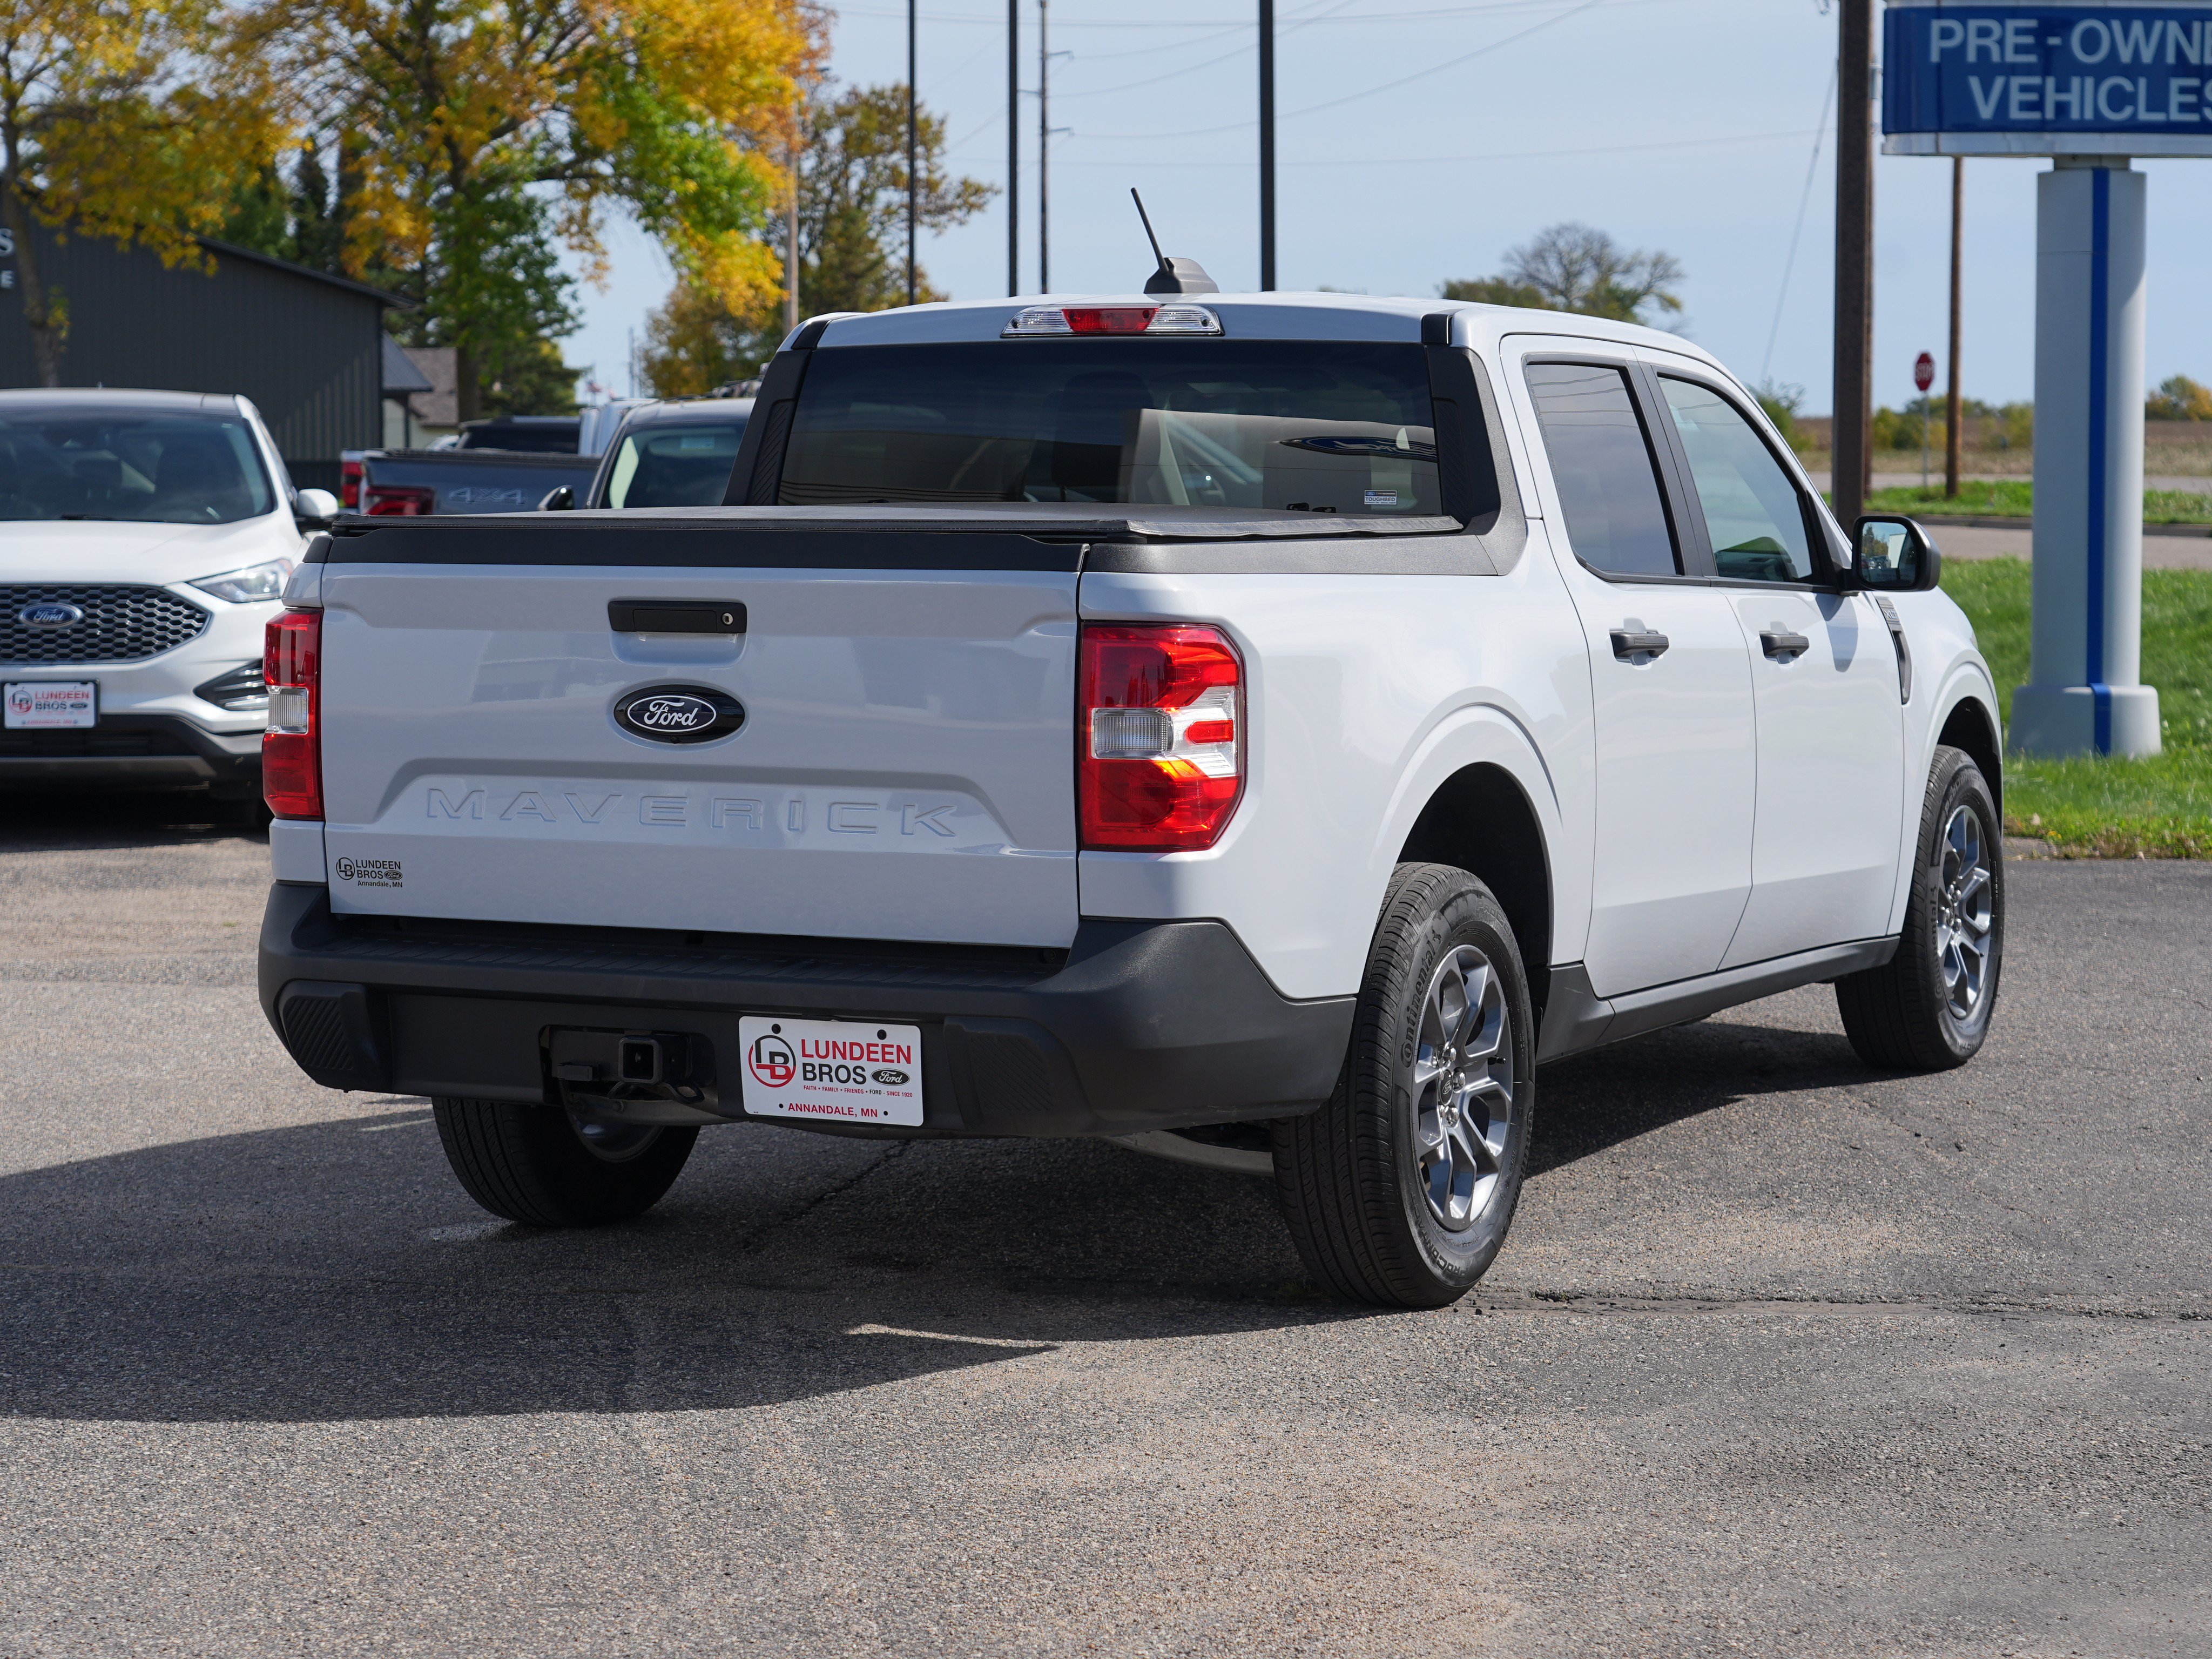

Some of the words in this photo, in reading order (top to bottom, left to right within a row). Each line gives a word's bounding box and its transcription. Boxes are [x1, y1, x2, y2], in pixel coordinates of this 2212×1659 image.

[1930, 18, 2212, 64] PRE-OWN
[1967, 76, 2212, 122] VEHICLE
[33, 609, 64, 622] Ford
[35, 691, 89, 699] LUNDEEN
[35, 701, 67, 710] BROS
[644, 700, 699, 726] Ford
[427, 788, 957, 837] MAVERICK
[355, 859, 401, 869] LUNDEEN
[357, 869, 383, 879] BROS
[358, 880, 392, 888] Annandale,
[1401, 940, 1436, 1068] Continental
[801, 1038, 911, 1064] LUNDEEN
[802, 1062, 867, 1085] BROS
[878, 1070, 903, 1084] Ford
[788, 1103, 858, 1117] ANNANDALE,
[861, 1108, 878, 1117] MN
